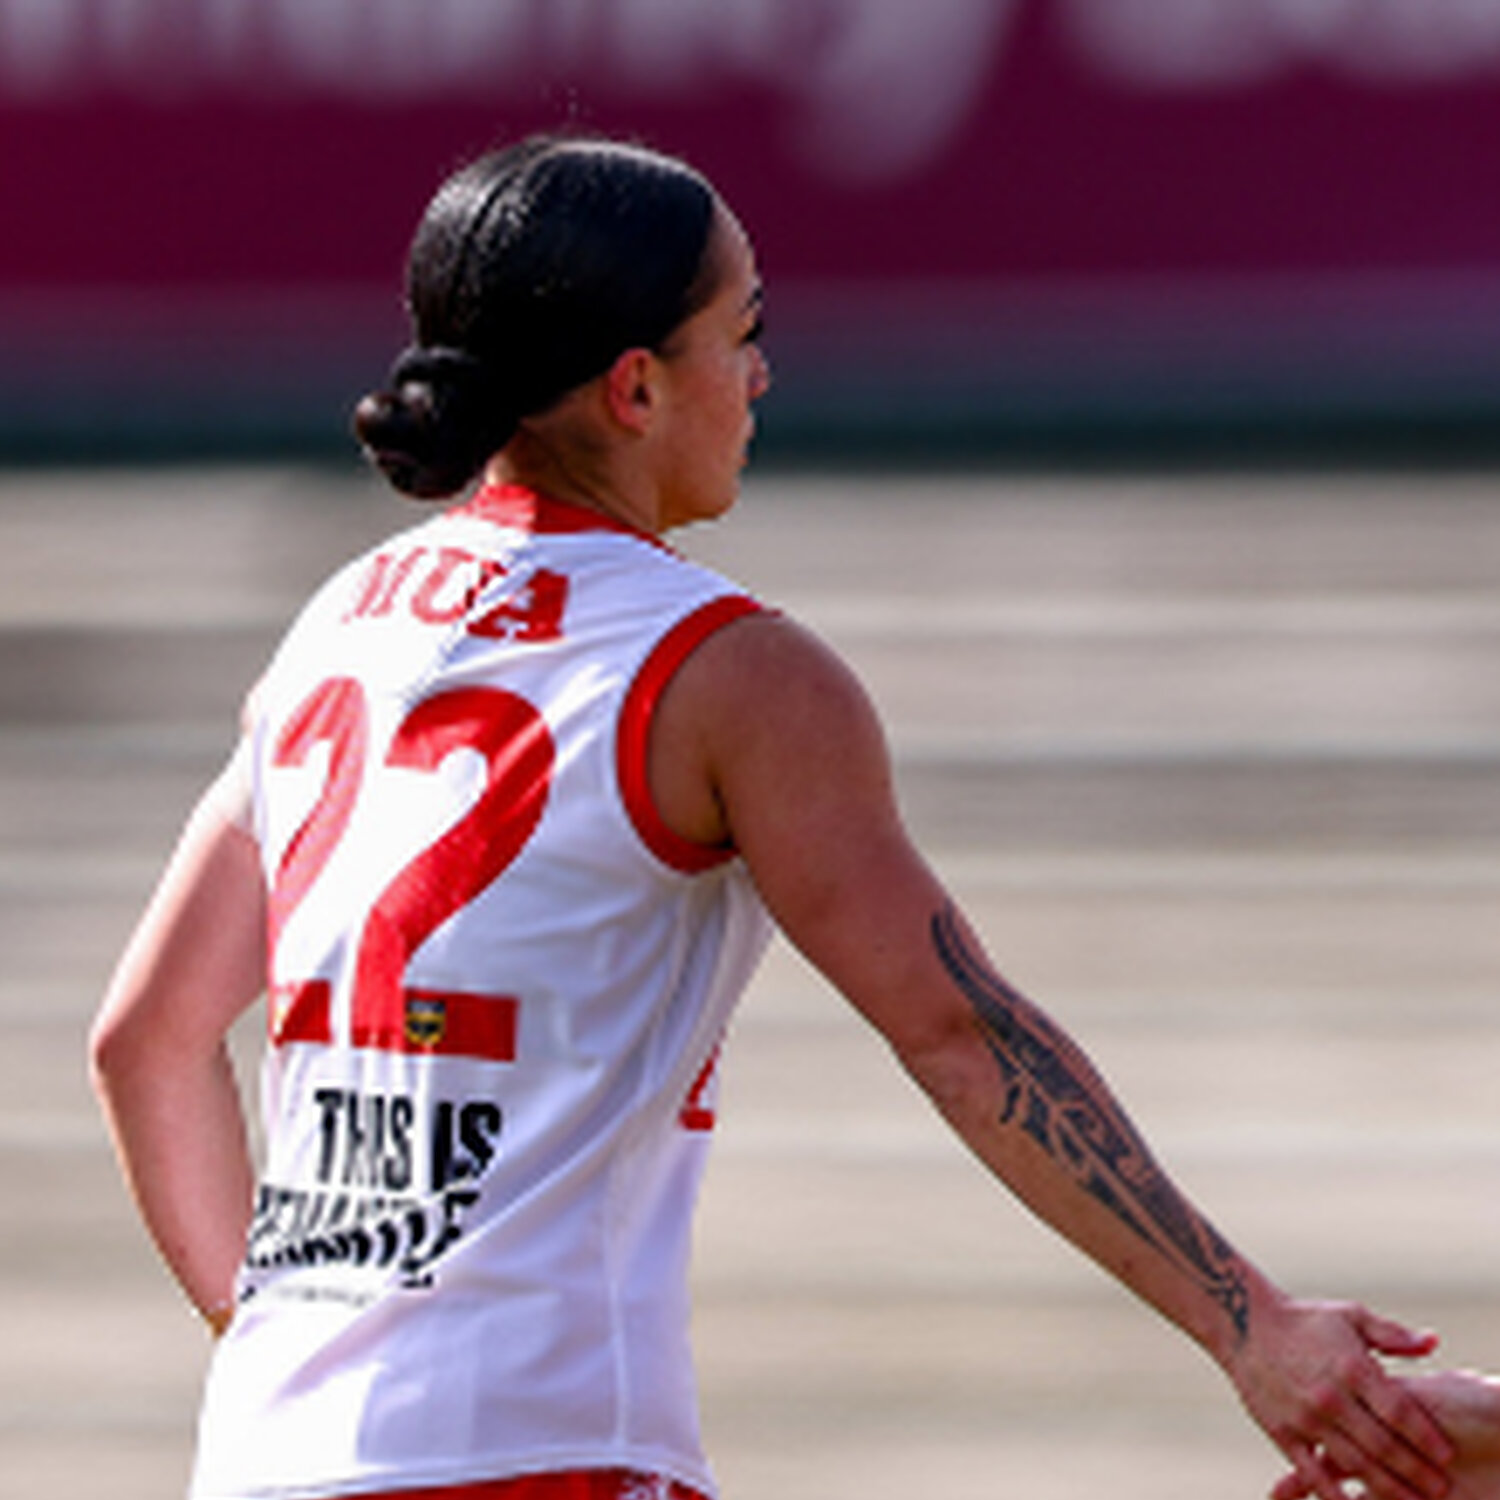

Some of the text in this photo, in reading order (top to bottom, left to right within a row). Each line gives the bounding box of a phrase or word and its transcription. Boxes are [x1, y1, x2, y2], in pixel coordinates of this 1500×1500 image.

[269, 677, 558, 1062] 22
[314, 1088, 502, 1192] THIS IS
